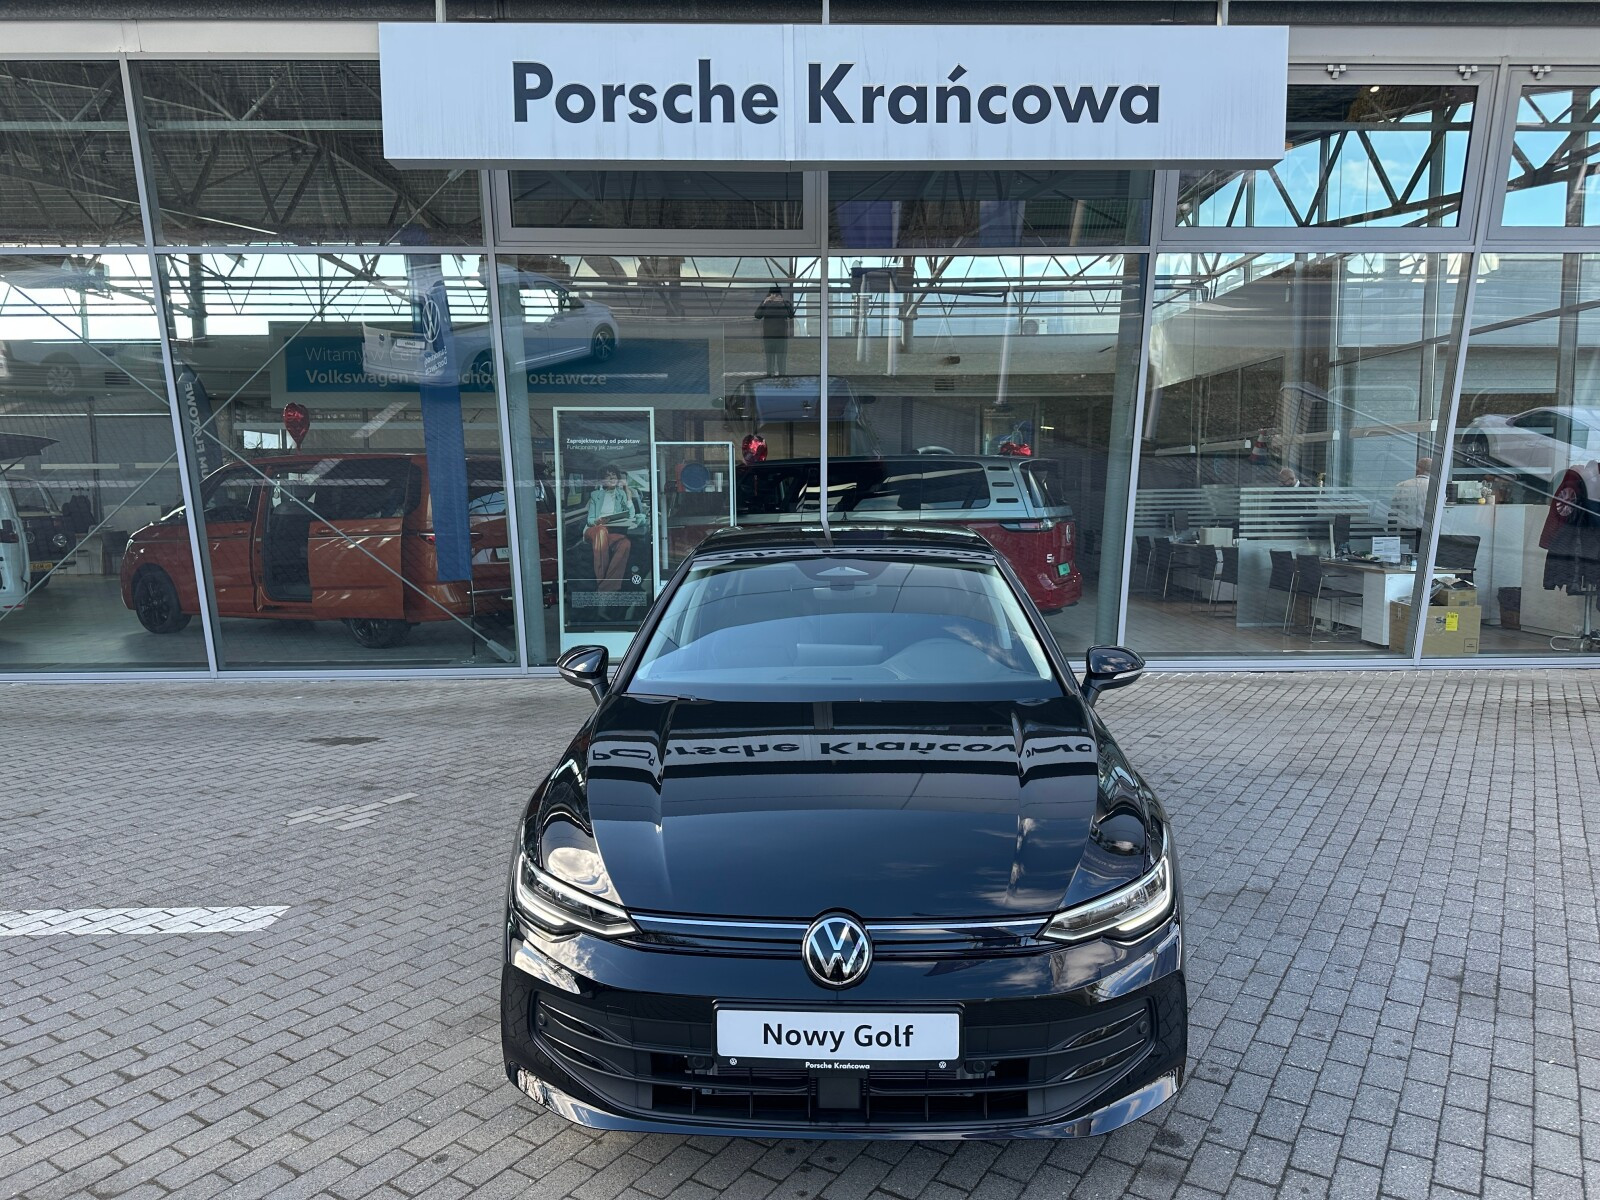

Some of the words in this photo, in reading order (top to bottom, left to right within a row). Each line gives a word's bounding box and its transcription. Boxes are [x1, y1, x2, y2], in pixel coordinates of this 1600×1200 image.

[513, 59, 778, 124] Porsche
[809, 64, 1159, 125] Krańcowa
[305, 346, 364, 363] Witamy
[306, 369, 409, 387] Volkswagen
[528, 373, 607, 385] ostawcze
[763, 1023, 845, 1053] Nowy
[854, 1024, 914, 1048] Golf
[805, 1061, 832, 1070] Porsche
[833, 1061, 871, 1070] Krańcowa
